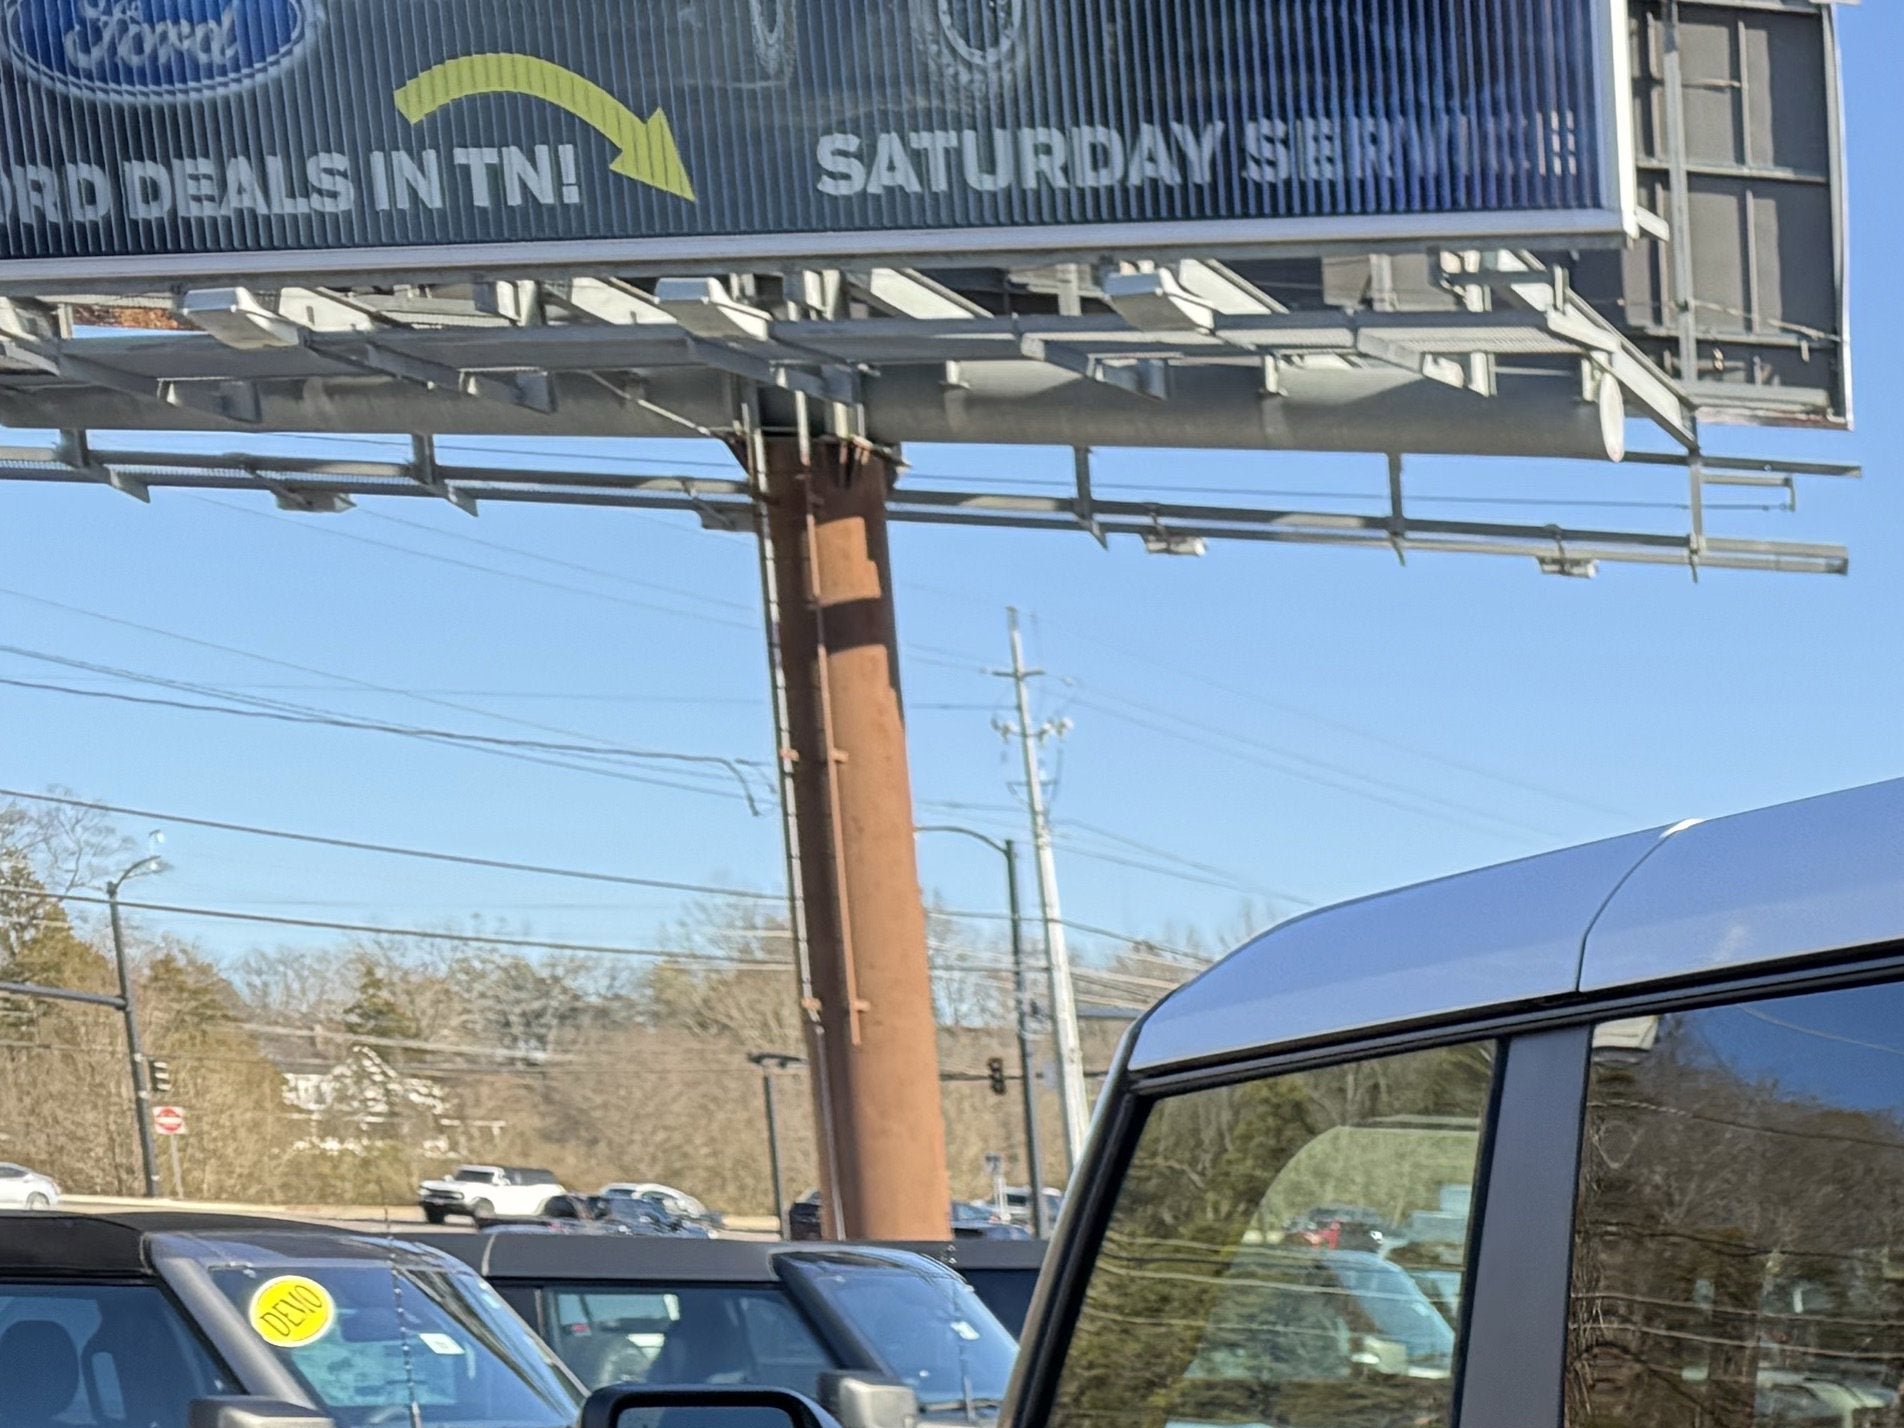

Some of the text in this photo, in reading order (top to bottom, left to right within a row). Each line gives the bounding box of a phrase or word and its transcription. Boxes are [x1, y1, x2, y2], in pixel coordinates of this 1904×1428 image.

[64, 0, 239, 69] Ford
[122, 152, 354, 220] DEALS
[370, 148, 443, 212] IN
[453, 144, 580, 208] TN!
[815, 120, 1226, 197] SATURDAY
[259, 1284, 323, 1338] DEMO
